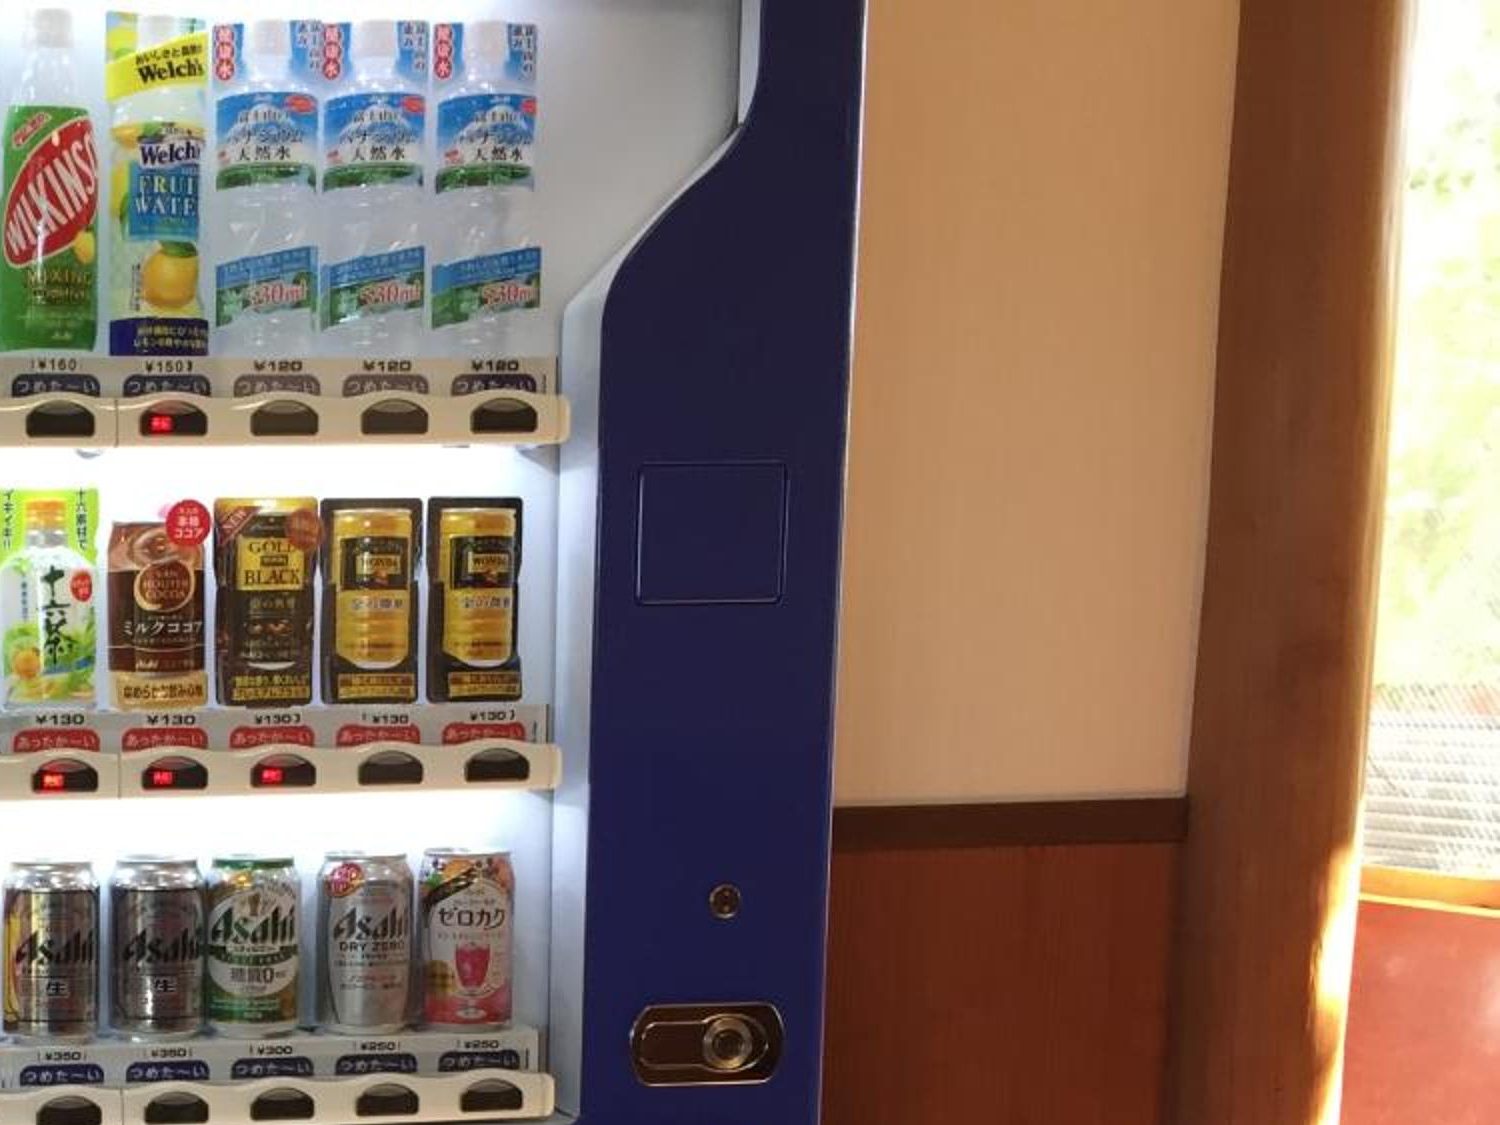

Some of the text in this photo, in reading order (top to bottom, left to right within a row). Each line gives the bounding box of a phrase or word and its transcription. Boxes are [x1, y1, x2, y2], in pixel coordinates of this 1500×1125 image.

[140, 141, 200, 165] Welch
[136, 197, 196, 216] WATE
[38, 358, 77, 371] ¥160
[145, 360, 187, 372] ¥150
[253, 360, 303, 372] ¥120
[363, 360, 412, 372] ¥120
[471, 359, 519, 371] ¥120
[221, 510, 247, 533] NEW
[244, 570, 300, 584] BLACK
[40, 565, 78, 665] 十六茶
[122, 620, 203, 636] ミルクココア
[35, 713, 86, 726] ¥130
[147, 715, 196, 725] ¥130
[254, 714, 294, 725] ¥130
[371, 714, 409, 725] ¥130
[469, 711, 507, 722] ¥130
[211, 903, 296, 943] Asahi
[437, 907, 506, 930] ゼロカク
[15, 929, 94, 964] Asahi
[339, 941, 366, 952] DRY
[45, 980, 68, 994] 生
[153, 978, 176, 993] 生
[361, 1041, 396, 1051] ¥250
[464, 1039, 500, 1049] ¥250
[45, 1051, 82, 1061] ¥350
[151, 1048, 187, 1058] ¥350
[257, 1045, 293, 1056] ¥300
